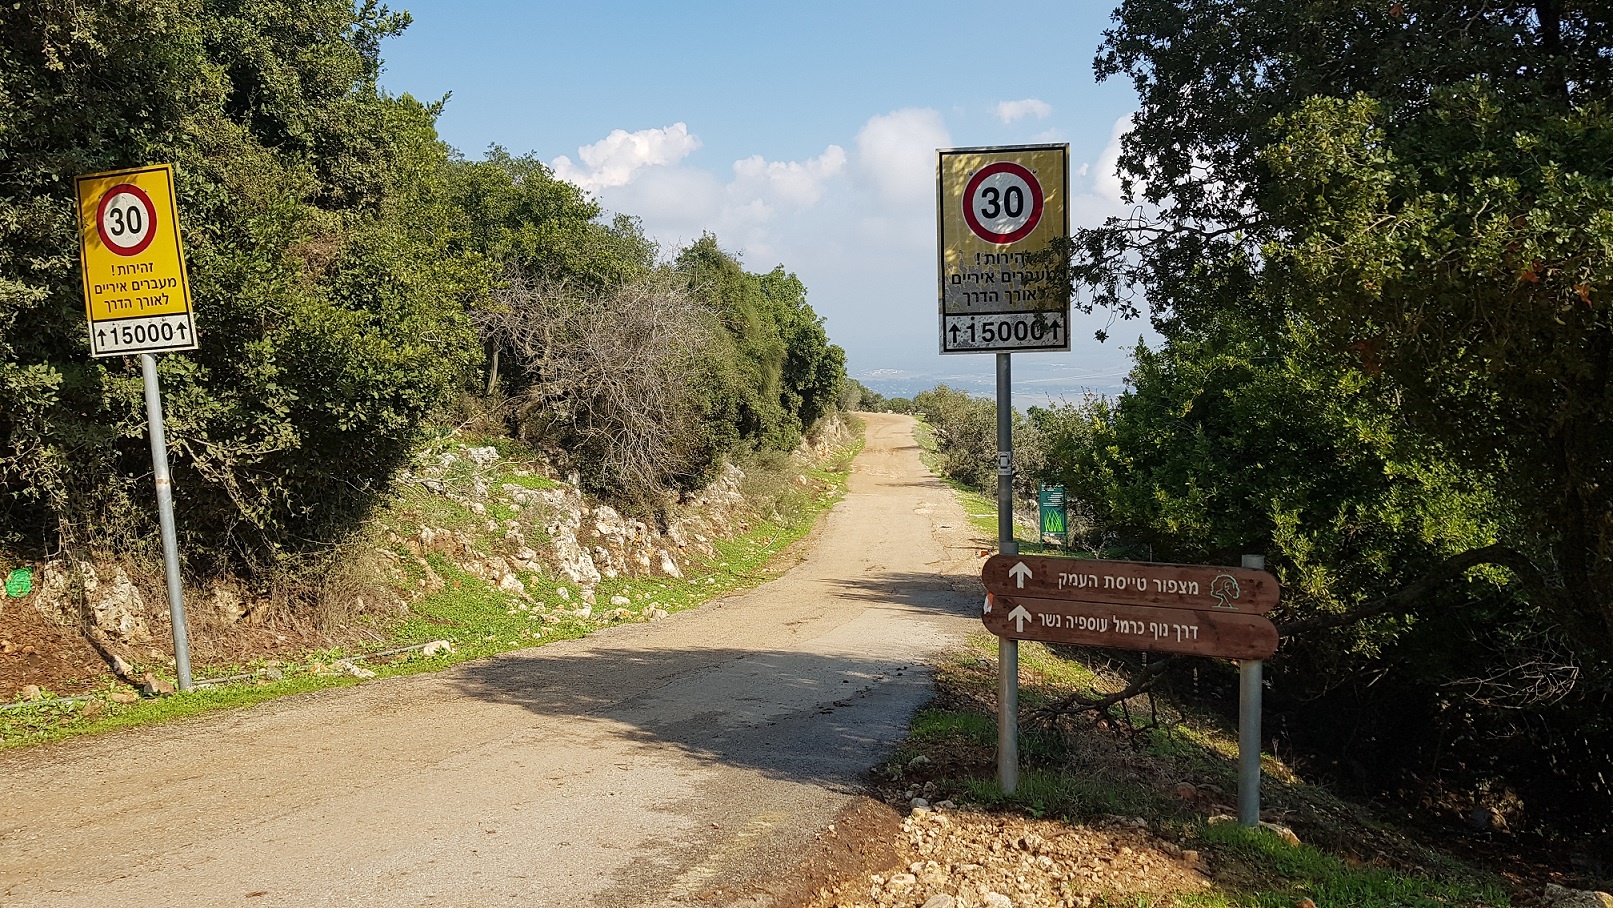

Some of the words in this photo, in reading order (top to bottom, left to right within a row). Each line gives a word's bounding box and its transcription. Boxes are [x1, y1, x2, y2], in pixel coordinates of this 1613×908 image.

[981, 186, 1024, 219] 30
[110, 206, 142, 236] 30
[131, 276, 177, 291] מעברים
[952, 272, 995, 285] איריים
[95, 281, 127, 295] איריים
[104, 297, 132, 313] הדרך
[136, 293, 170, 311] לאורך
[962, 291, 999, 307] הדרך
[110, 322, 174, 346] 15000
[966, 319, 1044, 343] 15000
[1058, 571, 1098, 590] העמק
[1103, 574, 1147, 592] טייסת
[1153, 578, 1199, 595] מצפור
[1038, 612, 1061, 628] נשר
[1066, 615, 1108, 633] עוספיה
[1112, 615, 1145, 635] כרמל
[1150, 622, 1169, 640] נוף
[1175, 624, 1199, 642] דרך
